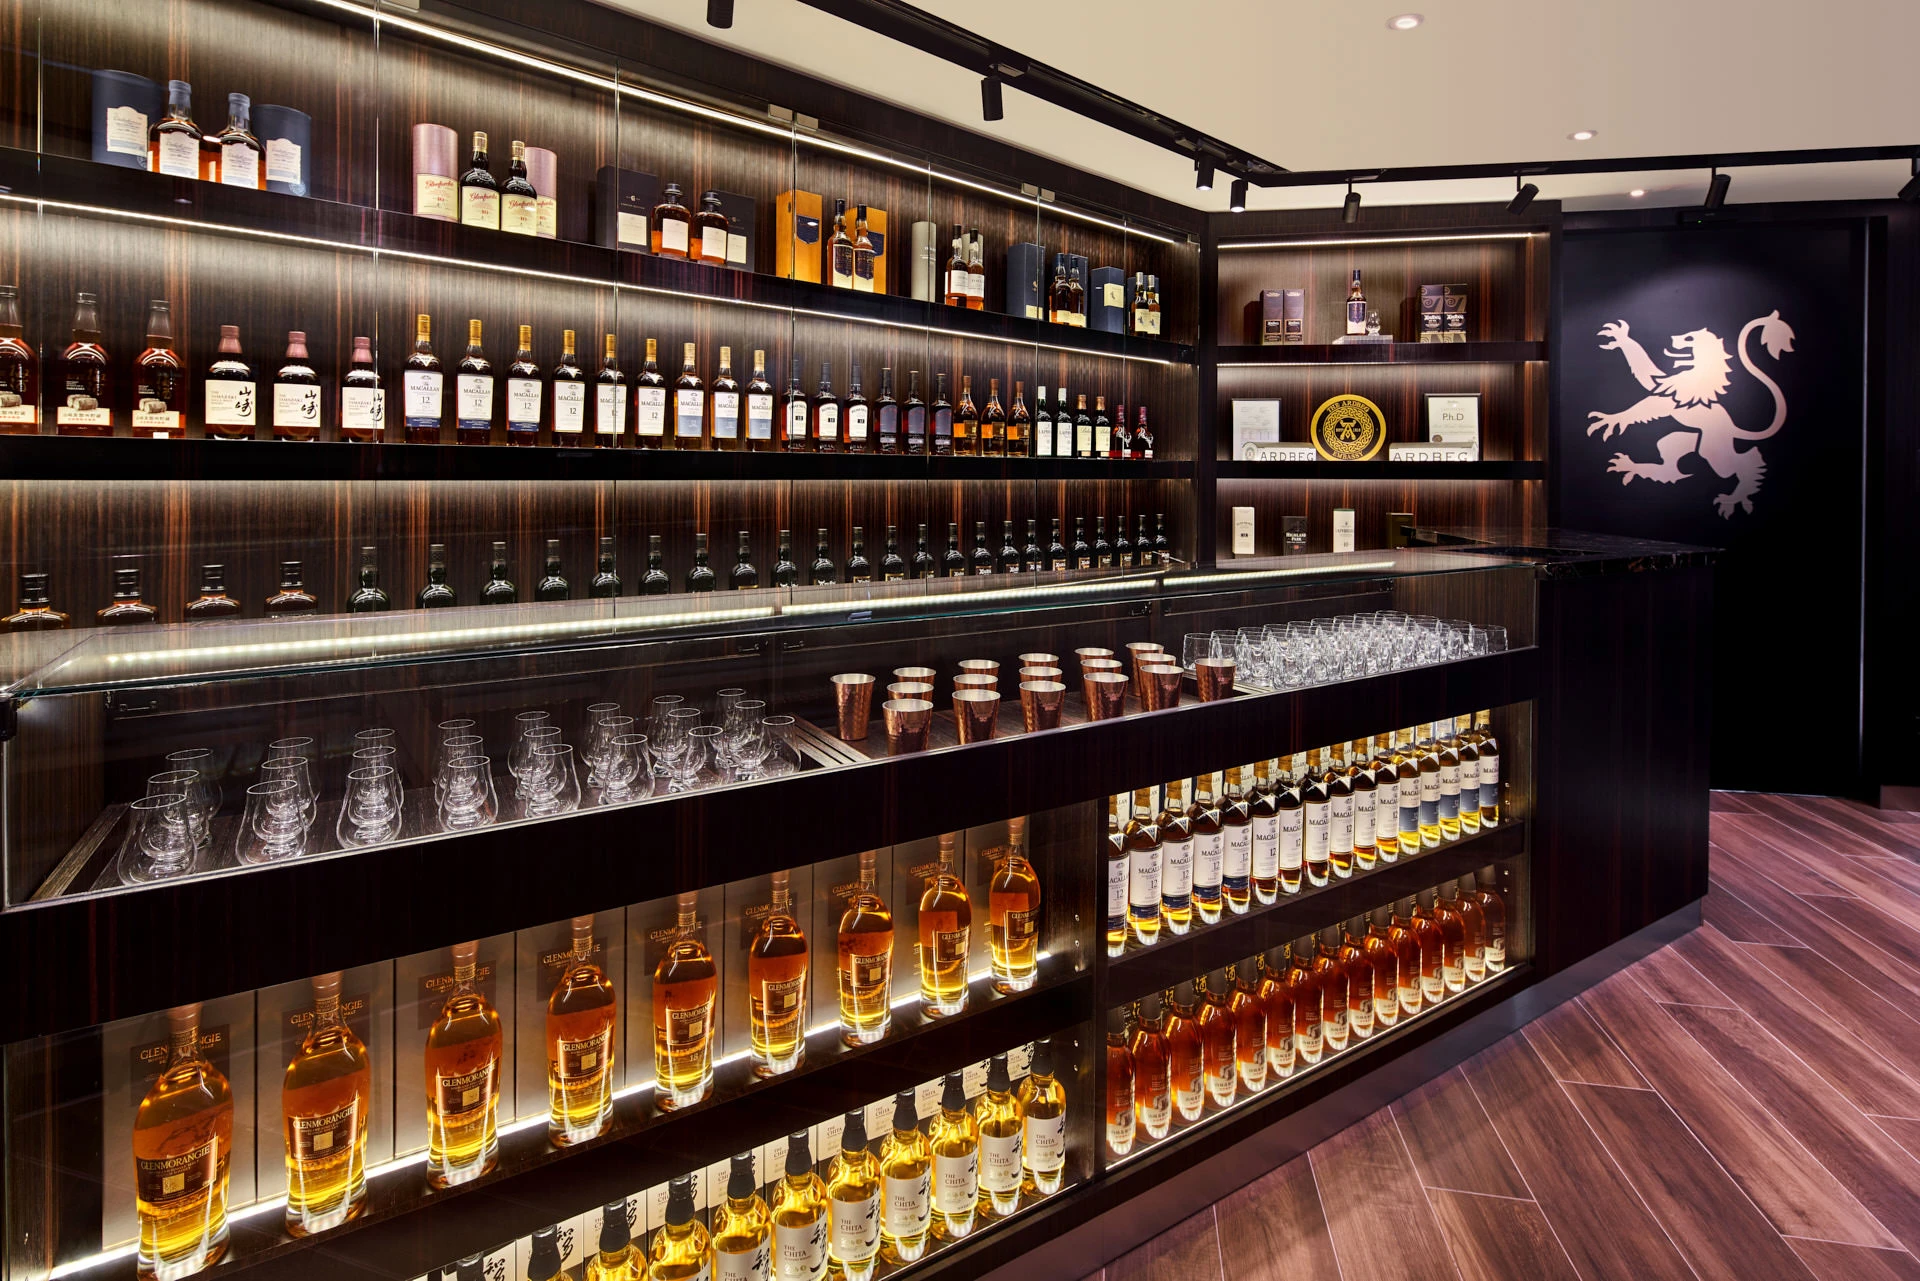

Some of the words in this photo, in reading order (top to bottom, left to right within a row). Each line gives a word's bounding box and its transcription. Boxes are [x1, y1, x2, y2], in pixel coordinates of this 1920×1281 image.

[1326, 402, 1340, 412] THE
[1342, 400, 1370, 413] ARDBEG
[1260, 452, 1314, 462] ARDBEG
[1332, 450, 1364, 460] EMBASSY
[1392, 451, 1469, 462] ARDBEG
[292, 1106, 355, 1129] GLENMORANGIE
[140, 1144, 211, 1170] GLENMORANGIE
[774, 1149, 787, 1158] CHIT
[840, 1224, 863, 1232] CHITA
[784, 1250, 807, 1258] CHITA
